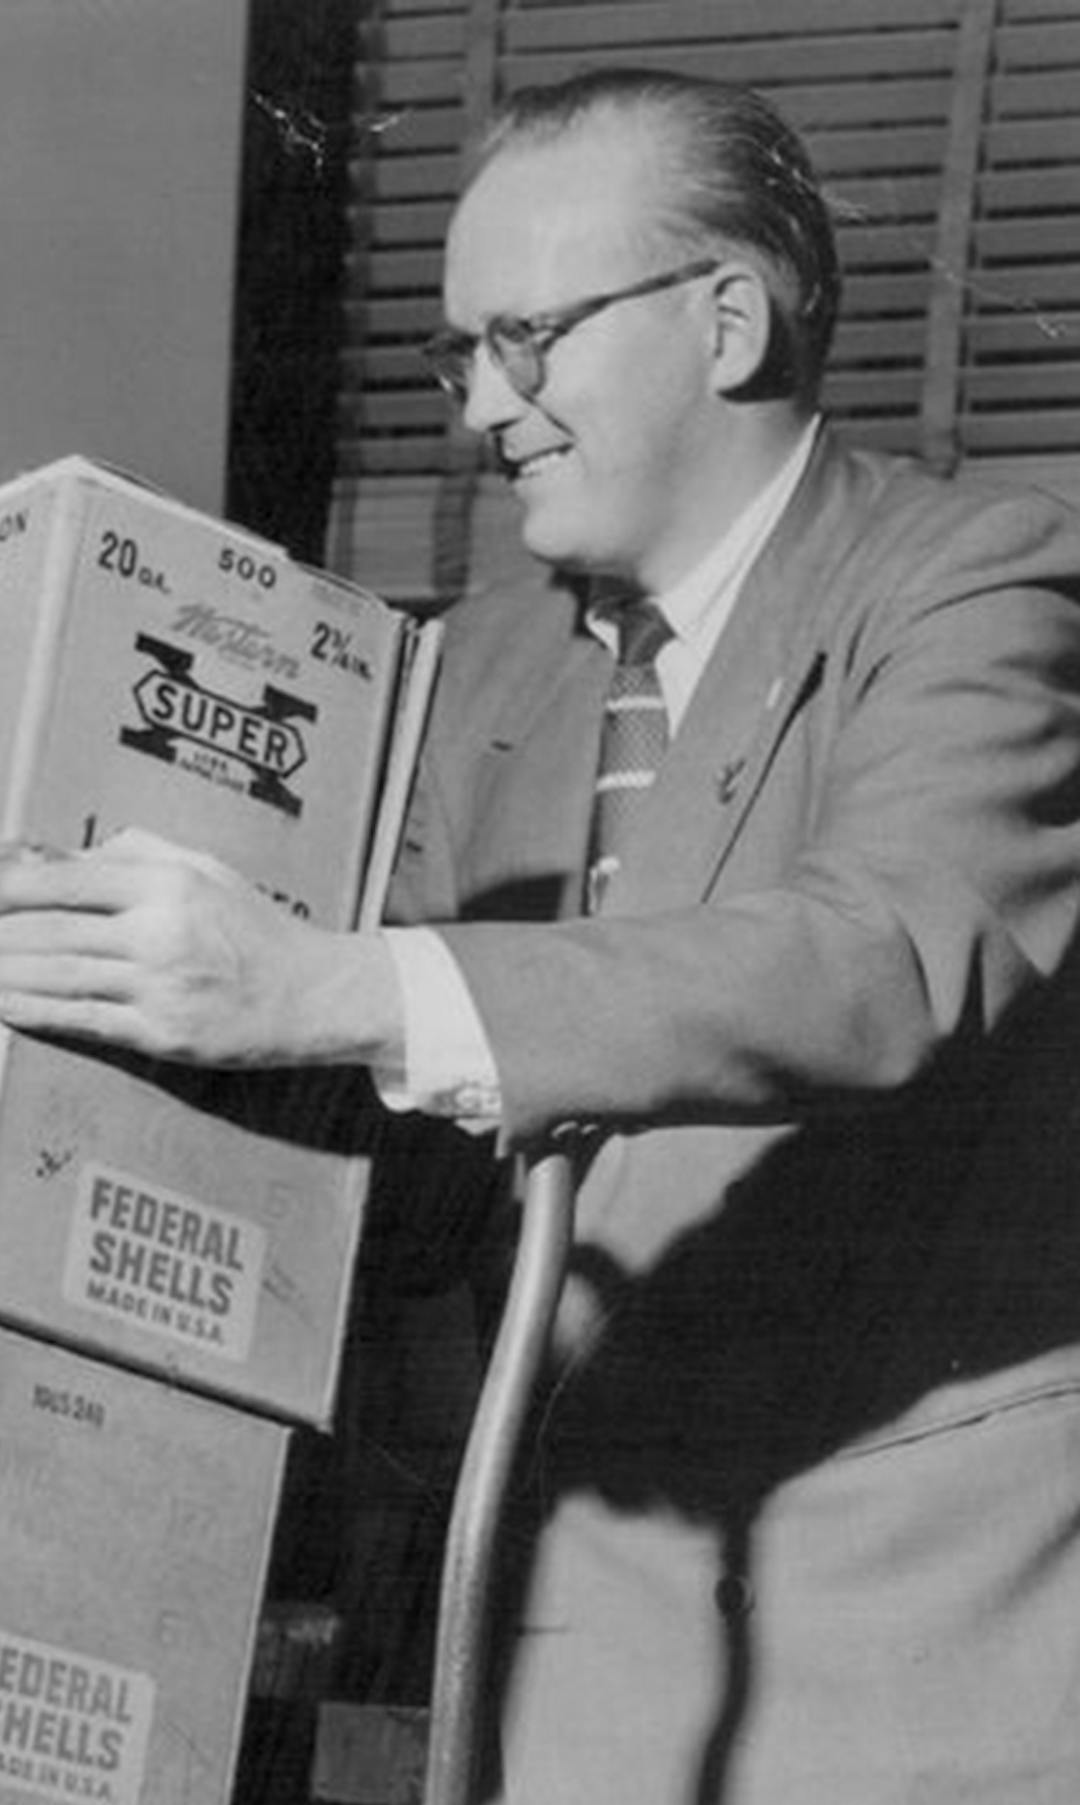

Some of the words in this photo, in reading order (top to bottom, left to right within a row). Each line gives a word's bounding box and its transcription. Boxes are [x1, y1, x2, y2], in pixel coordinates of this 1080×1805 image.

[218, 548, 277, 590] 500
[151, 680, 294, 770] SUPER
[89, 1176, 245, 1273] FEDERAL
[85, 1279, 147, 1321] MADE
[150, 1299, 172, 1327] IN
[88, 1230, 235, 1318] SHELLS
[37, 1763, 60, 1788] IN
